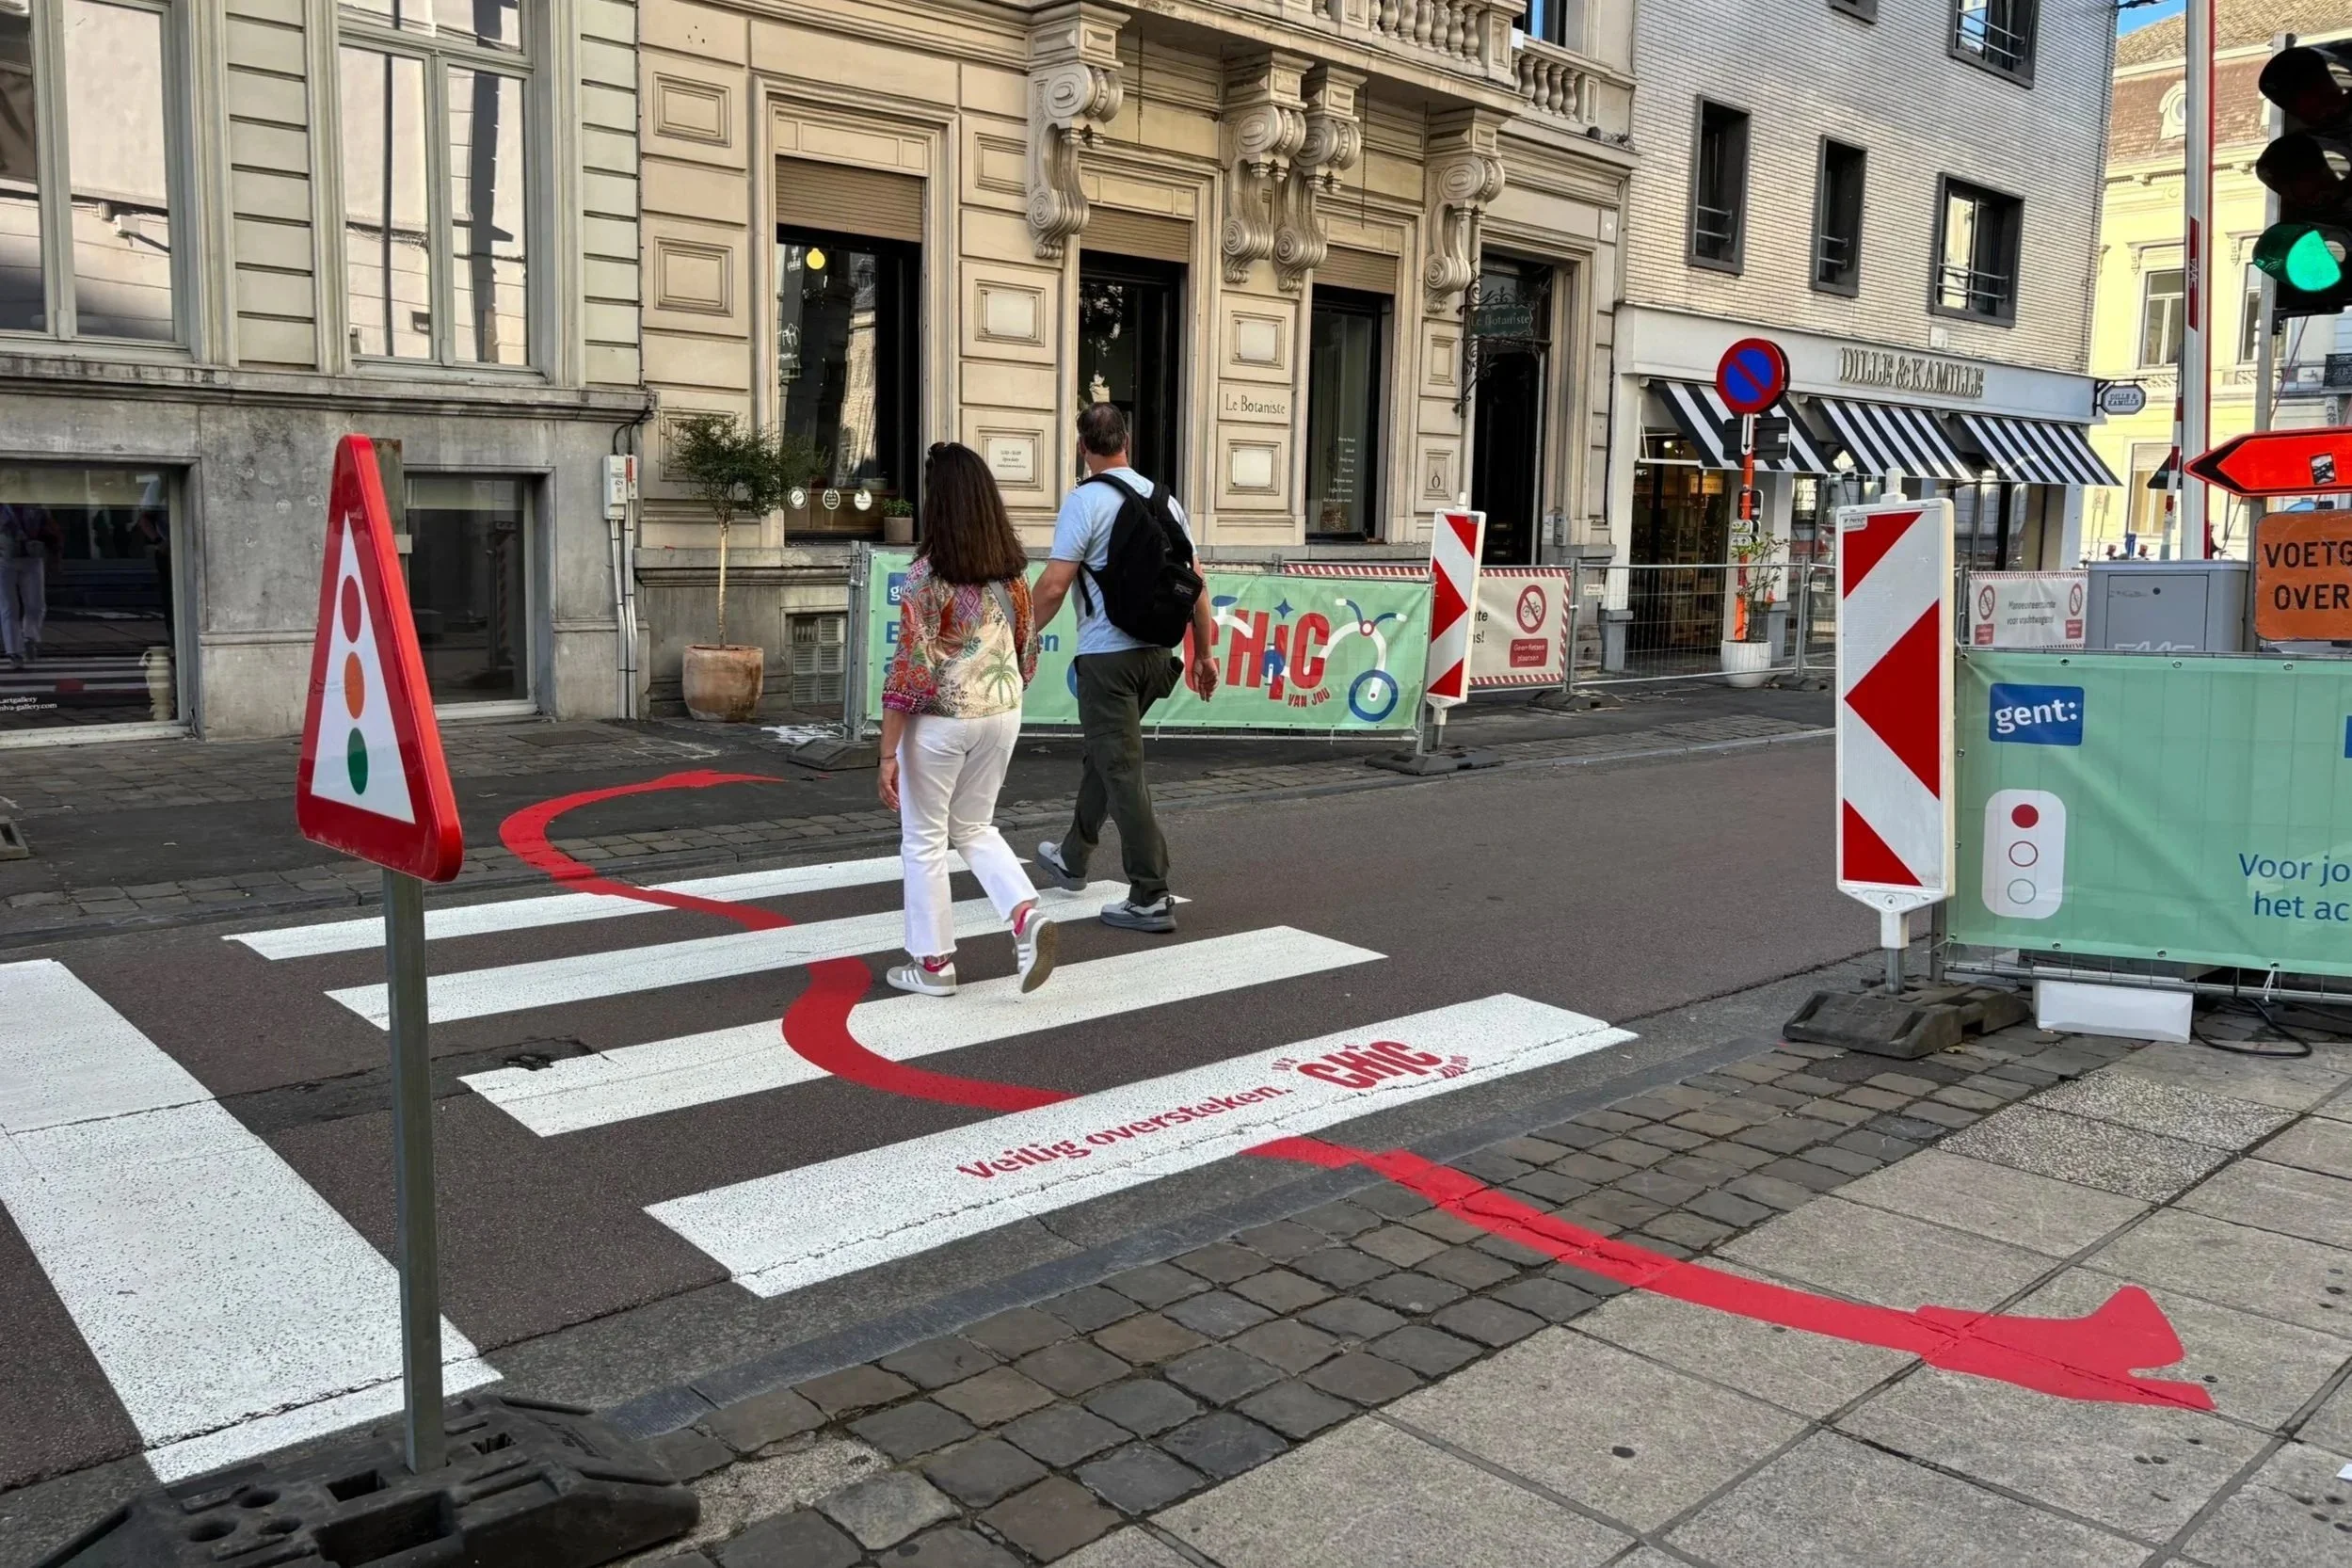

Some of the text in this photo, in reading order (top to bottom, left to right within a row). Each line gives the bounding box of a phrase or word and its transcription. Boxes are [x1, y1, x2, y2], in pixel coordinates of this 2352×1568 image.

[1840, 347, 1985, 398] DILLE & KAMILLE
[1225, 393, 1286, 414] Le Botaniste
[2274, 584, 2350, 611] OVER
[1288, 686, 1331, 708] VAN JOU
[1994, 699, 2078, 734] gent:
[2239, 852, 2312, 880] Voor
[2254, 890, 2304, 920] het
[954, 1084, 1294, 1179] Veilig oversteken.
